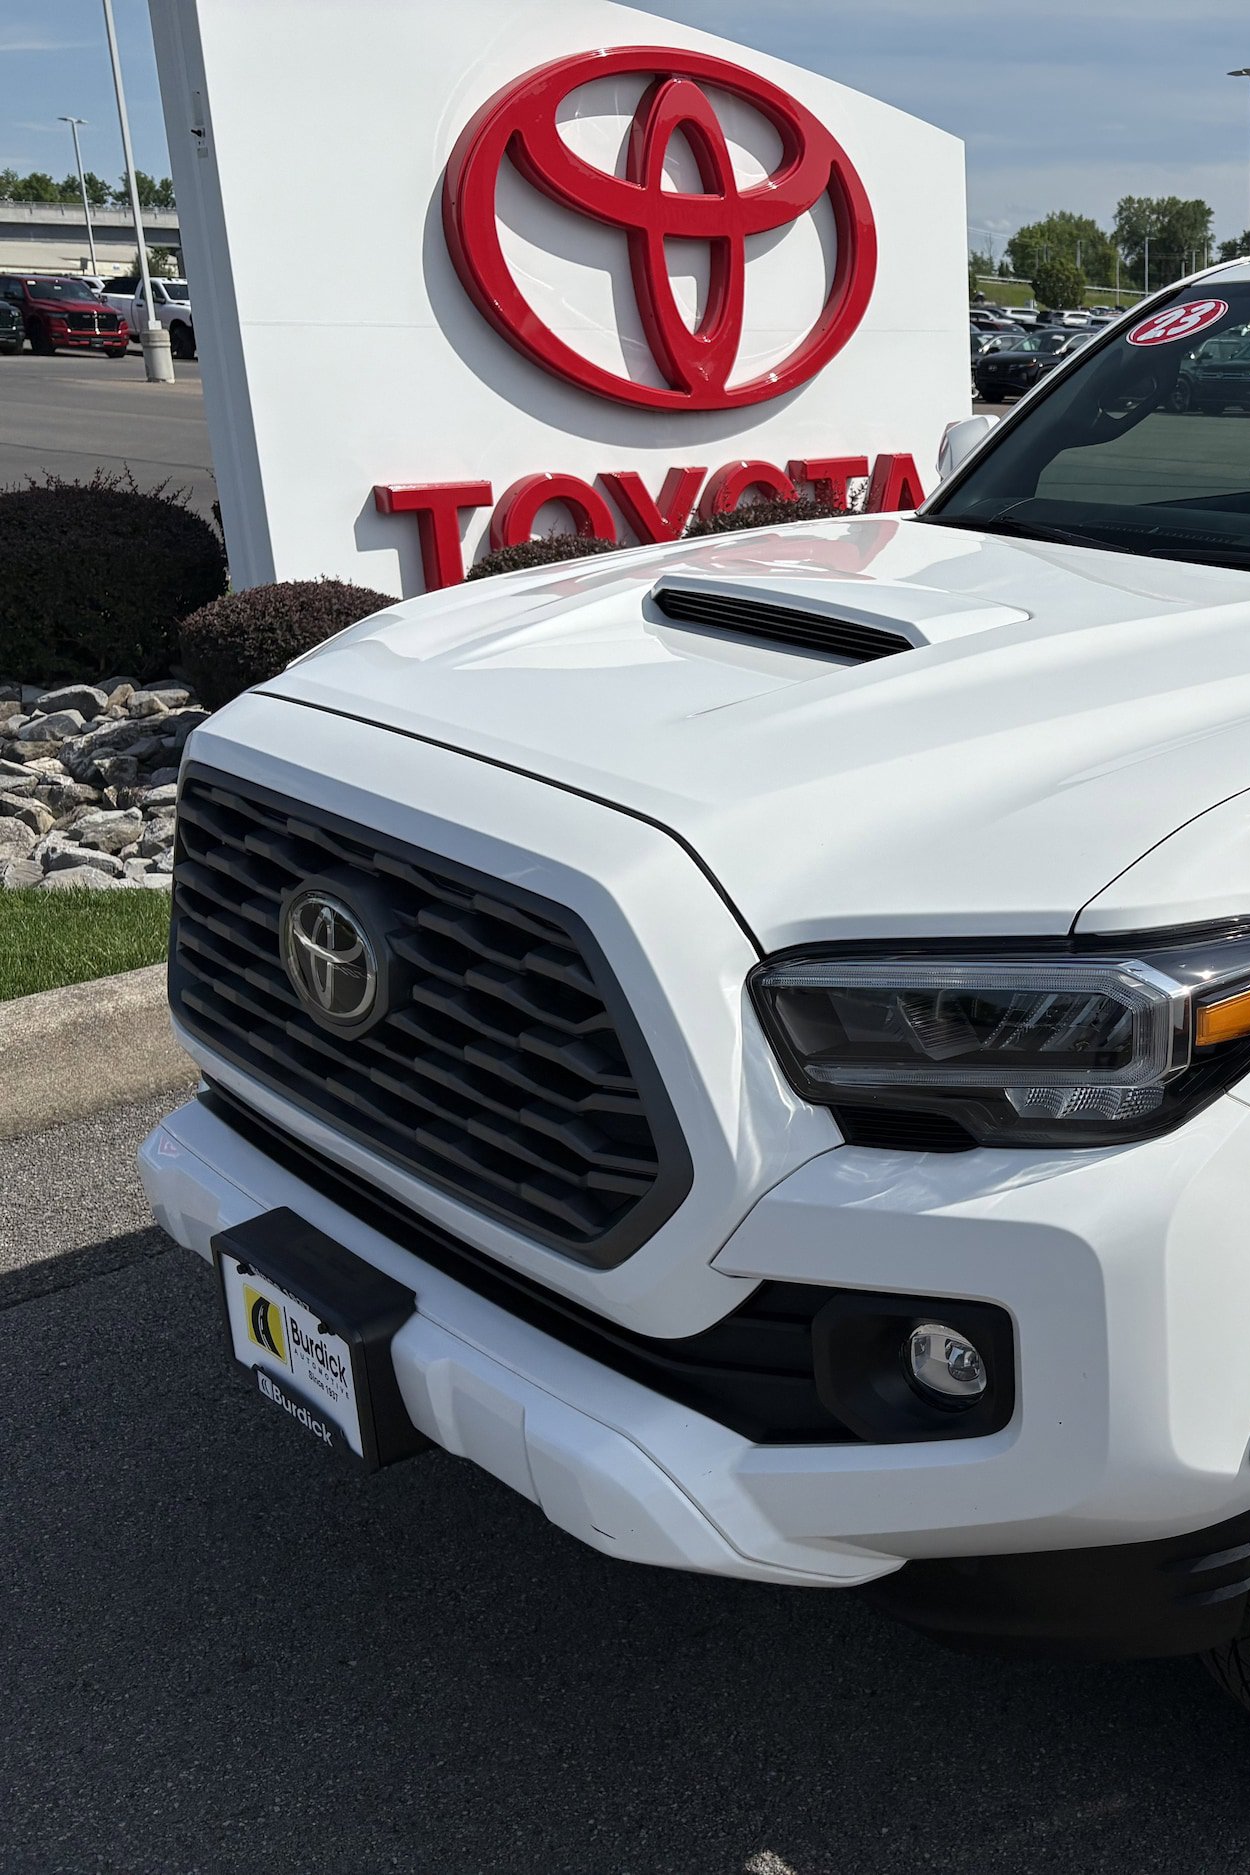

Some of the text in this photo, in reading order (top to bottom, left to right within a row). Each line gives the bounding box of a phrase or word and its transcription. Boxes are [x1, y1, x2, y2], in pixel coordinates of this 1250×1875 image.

[1137, 302, 1216, 341] 23
[374, 452, 928, 593] TOYOTA
[289, 1316, 348, 1388] Burdick
[294, 1349, 350, 1400] AUTOMOTIVE
[272, 1383, 333, 1447] Burdick
